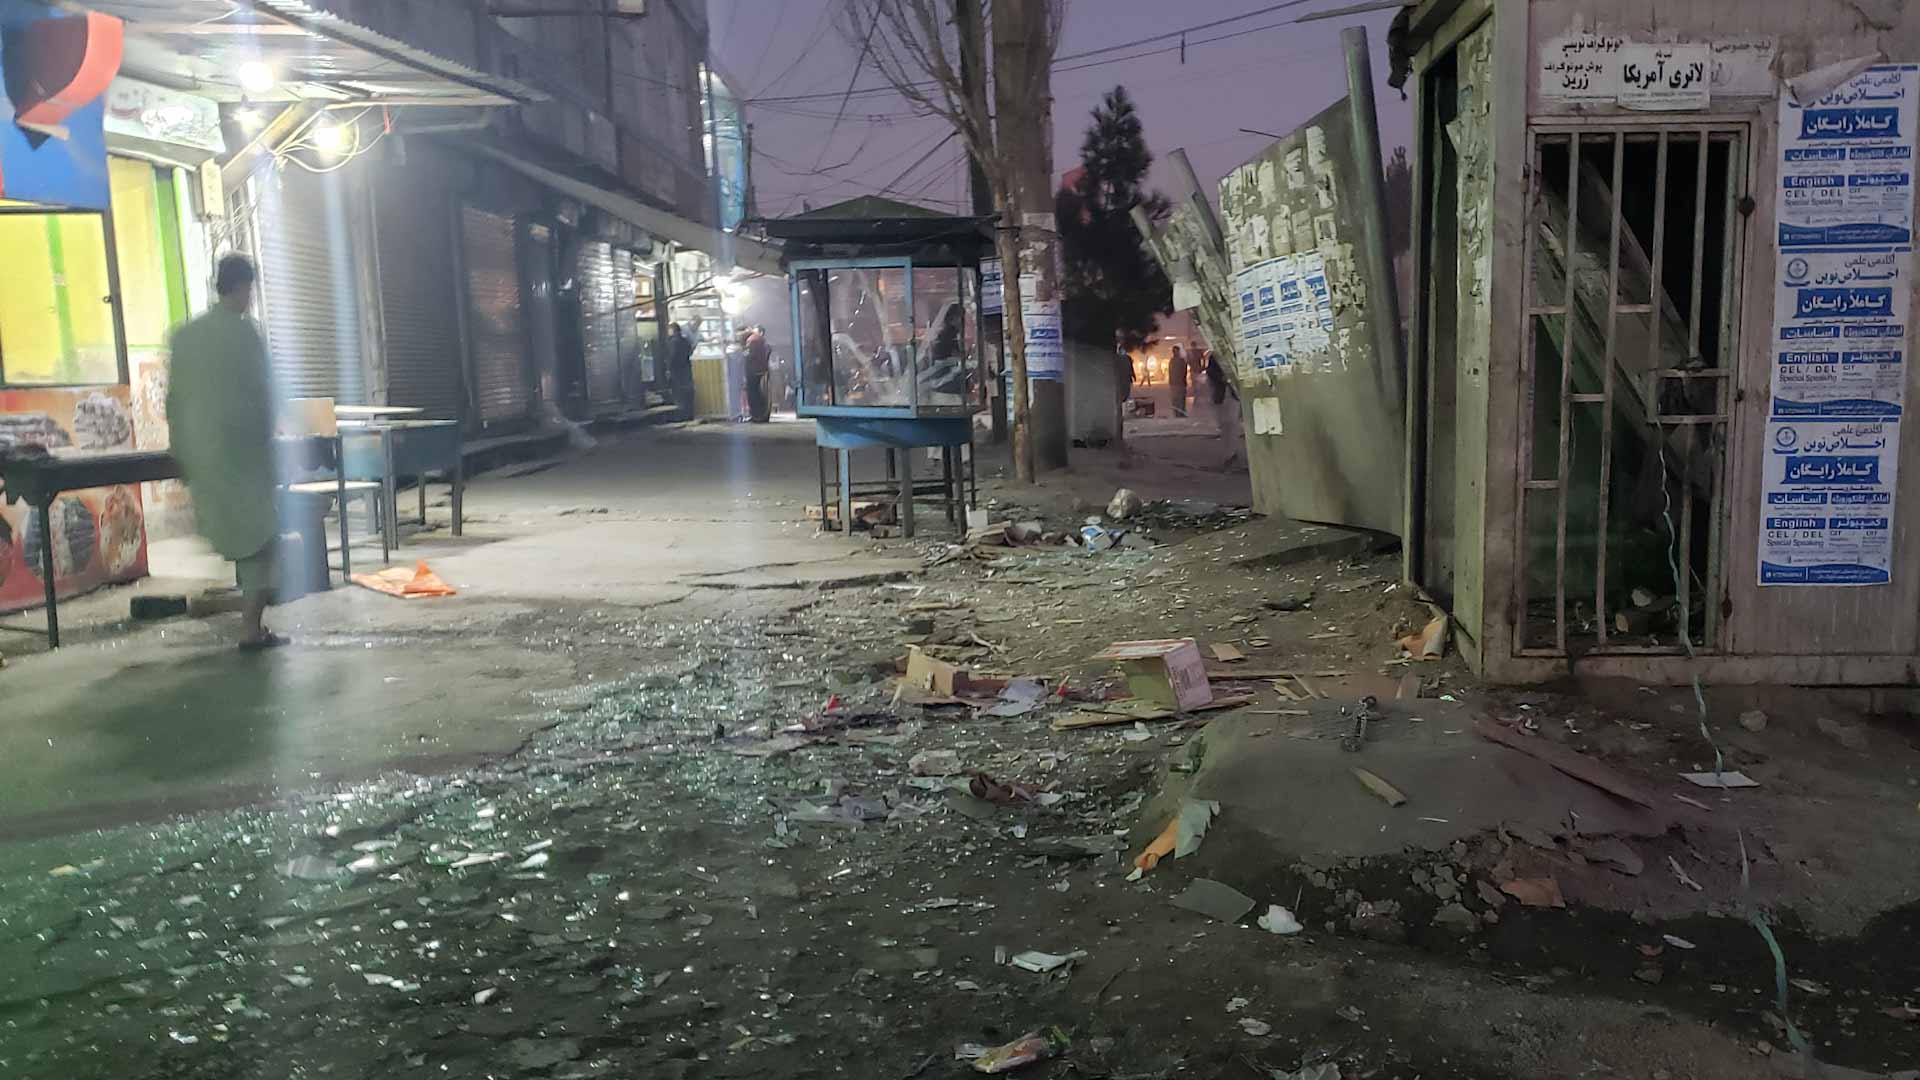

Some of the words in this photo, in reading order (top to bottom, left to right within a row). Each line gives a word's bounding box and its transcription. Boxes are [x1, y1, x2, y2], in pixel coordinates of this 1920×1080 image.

[1624, 60, 1666, 89] آمریکا
[1669, 63, 1703, 88] لاتری
[1562, 74, 1590, 90] زرین
[1791, 176, 1834, 188] English
[1784, 190, 1807, 198] CEL
[1821, 189, 1842, 197] DEL
[1802, 295, 1848, 313] رایگان
[1786, 353, 1829, 365] English
[1815, 365, 1837, 373] DEL
[1803, 438, 1826, 452] نوین
[1790, 463, 1835, 480] رایگان
[1773, 493, 1822, 504] اساسات
[1774, 518, 1817, 530] English
[1837, 518, 1882, 529] کمپیوتر
[1767, 530, 1790, 539] CEL
[1802, 530, 1823, 538] DEL
[1767, 538, 1791, 546] Special
[1792, 538, 1825, 548] Speaking
